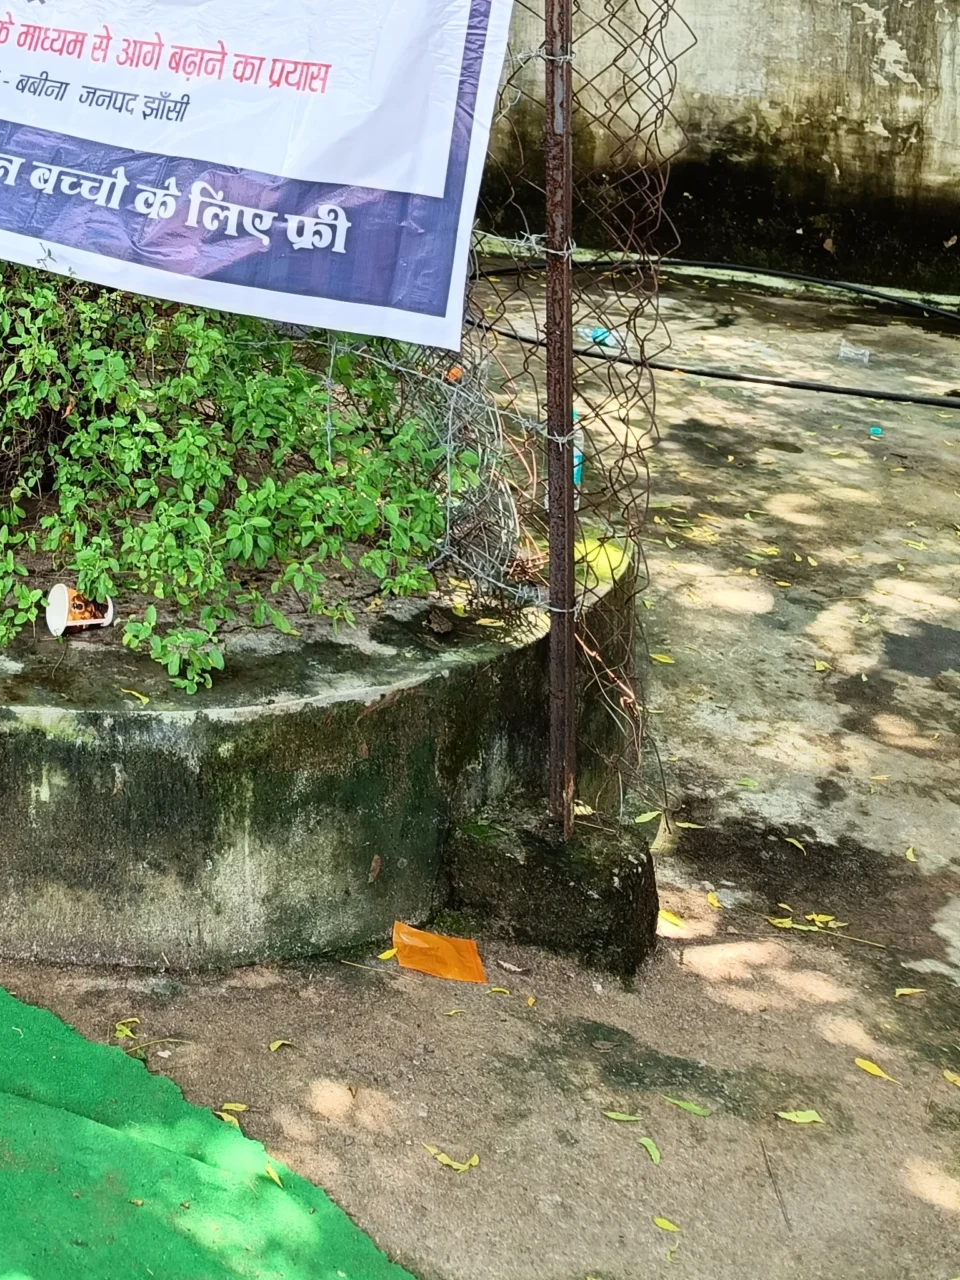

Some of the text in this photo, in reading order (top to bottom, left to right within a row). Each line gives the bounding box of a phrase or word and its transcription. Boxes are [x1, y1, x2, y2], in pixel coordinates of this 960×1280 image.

[16, 22, 88, 60] माध्यम
[90, 25, 112, 63] से
[116, 31, 165, 70] आगे
[168, 40, 228, 82] बढ़ाने
[232, 53, 266, 85] का
[268, 58, 332, 94] प्रयास
[15, 70, 70, 102] बबीना
[78, 85, 140, 116] जनपद
[142, 91, 191, 123] झाँसी
[29, 166, 129, 210] बच्चो
[133, 176, 183, 221] के
[184, 180, 279, 246] लिए
